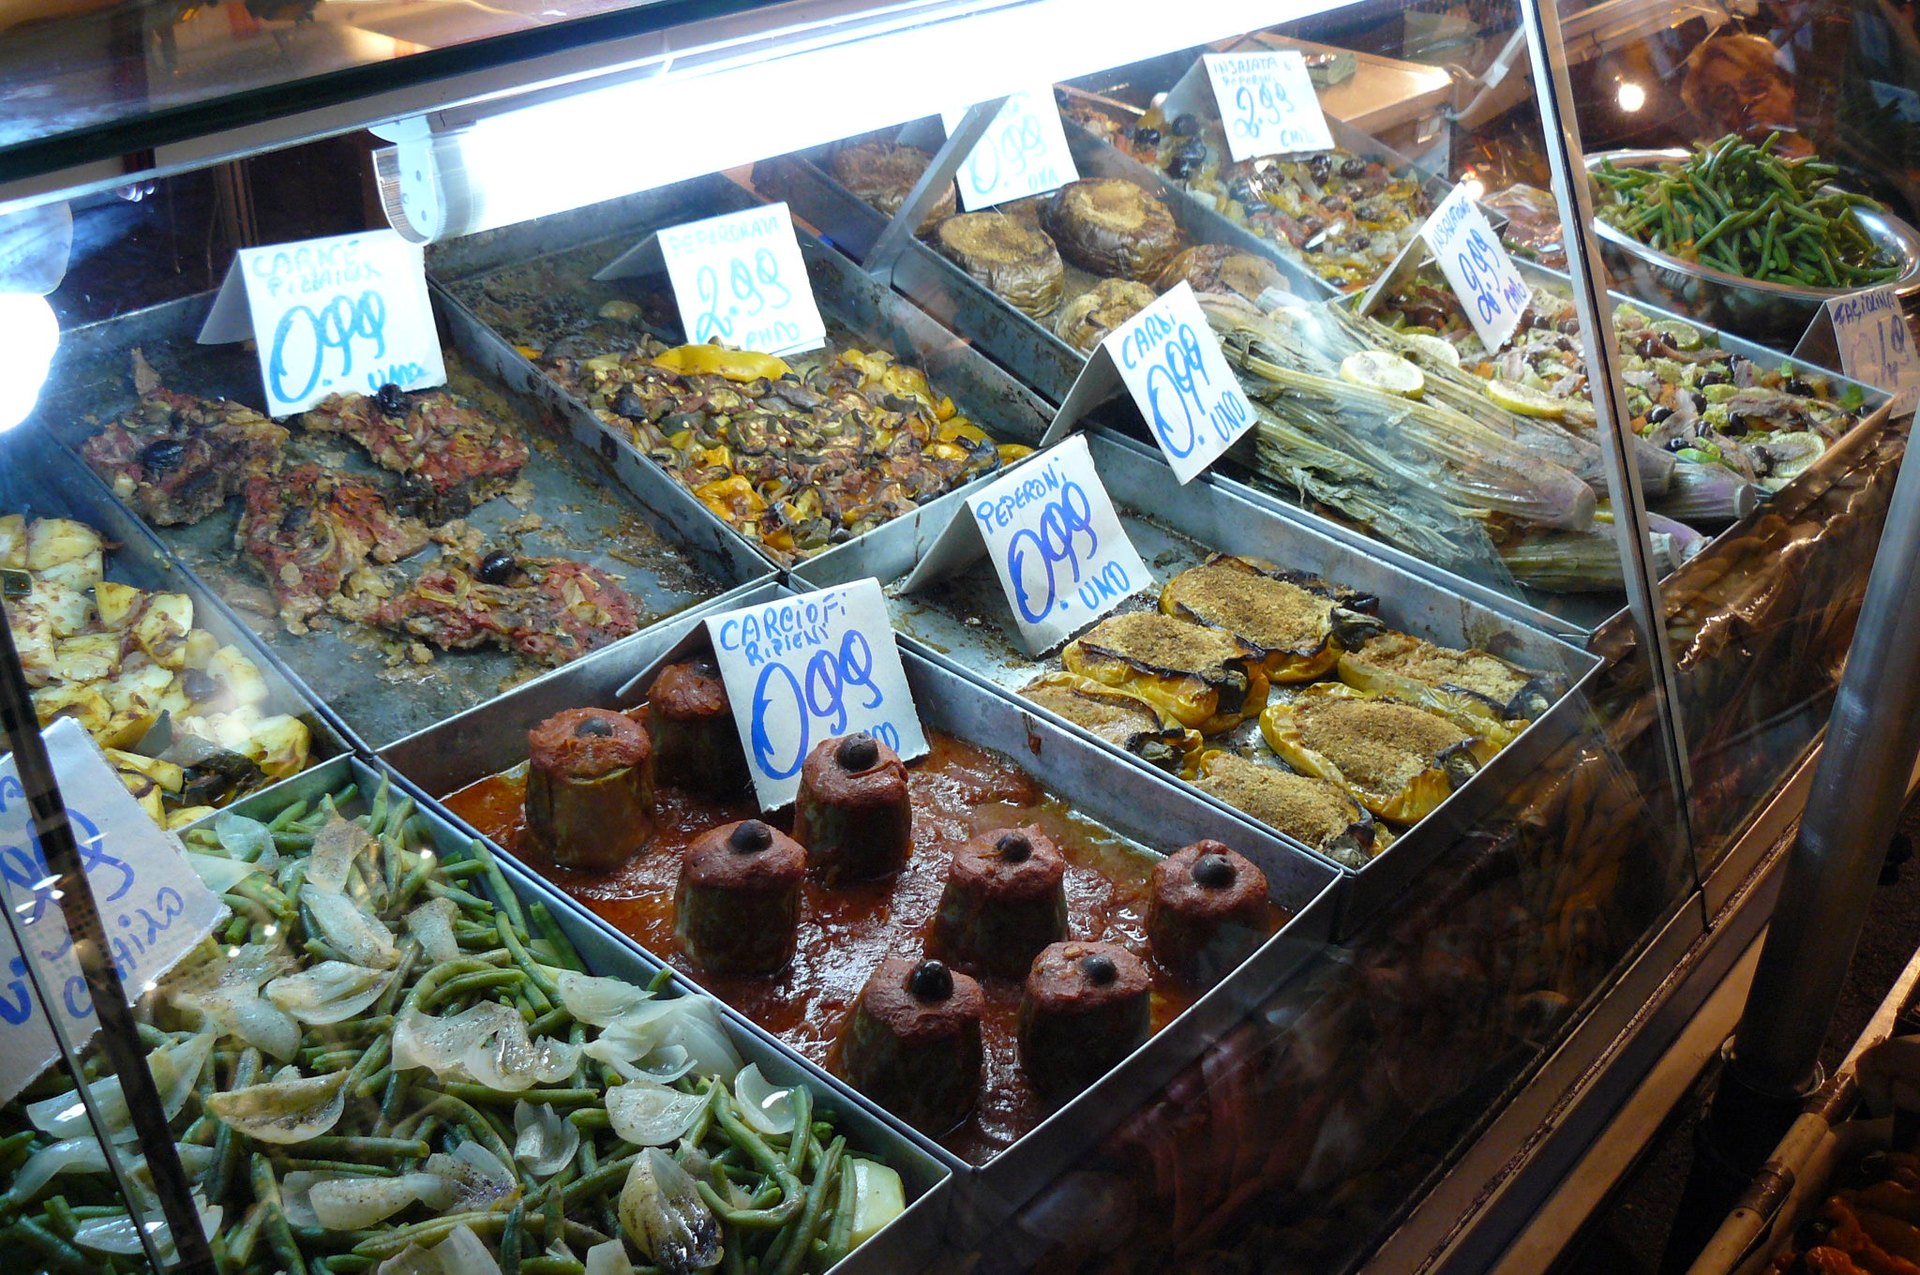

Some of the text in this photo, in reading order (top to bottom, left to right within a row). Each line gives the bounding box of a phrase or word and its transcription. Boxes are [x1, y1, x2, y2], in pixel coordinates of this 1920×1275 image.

[1233, 81, 1296, 139] 2.99
[695, 246, 793, 346] 2.99
[269, 290, 387, 403] 0.99
[1146, 323, 1211, 459] 0.99
[1210, 389, 1247, 443] UNO
[1007, 481, 1098, 624] 0.99
[1078, 560, 1131, 611] UNO
